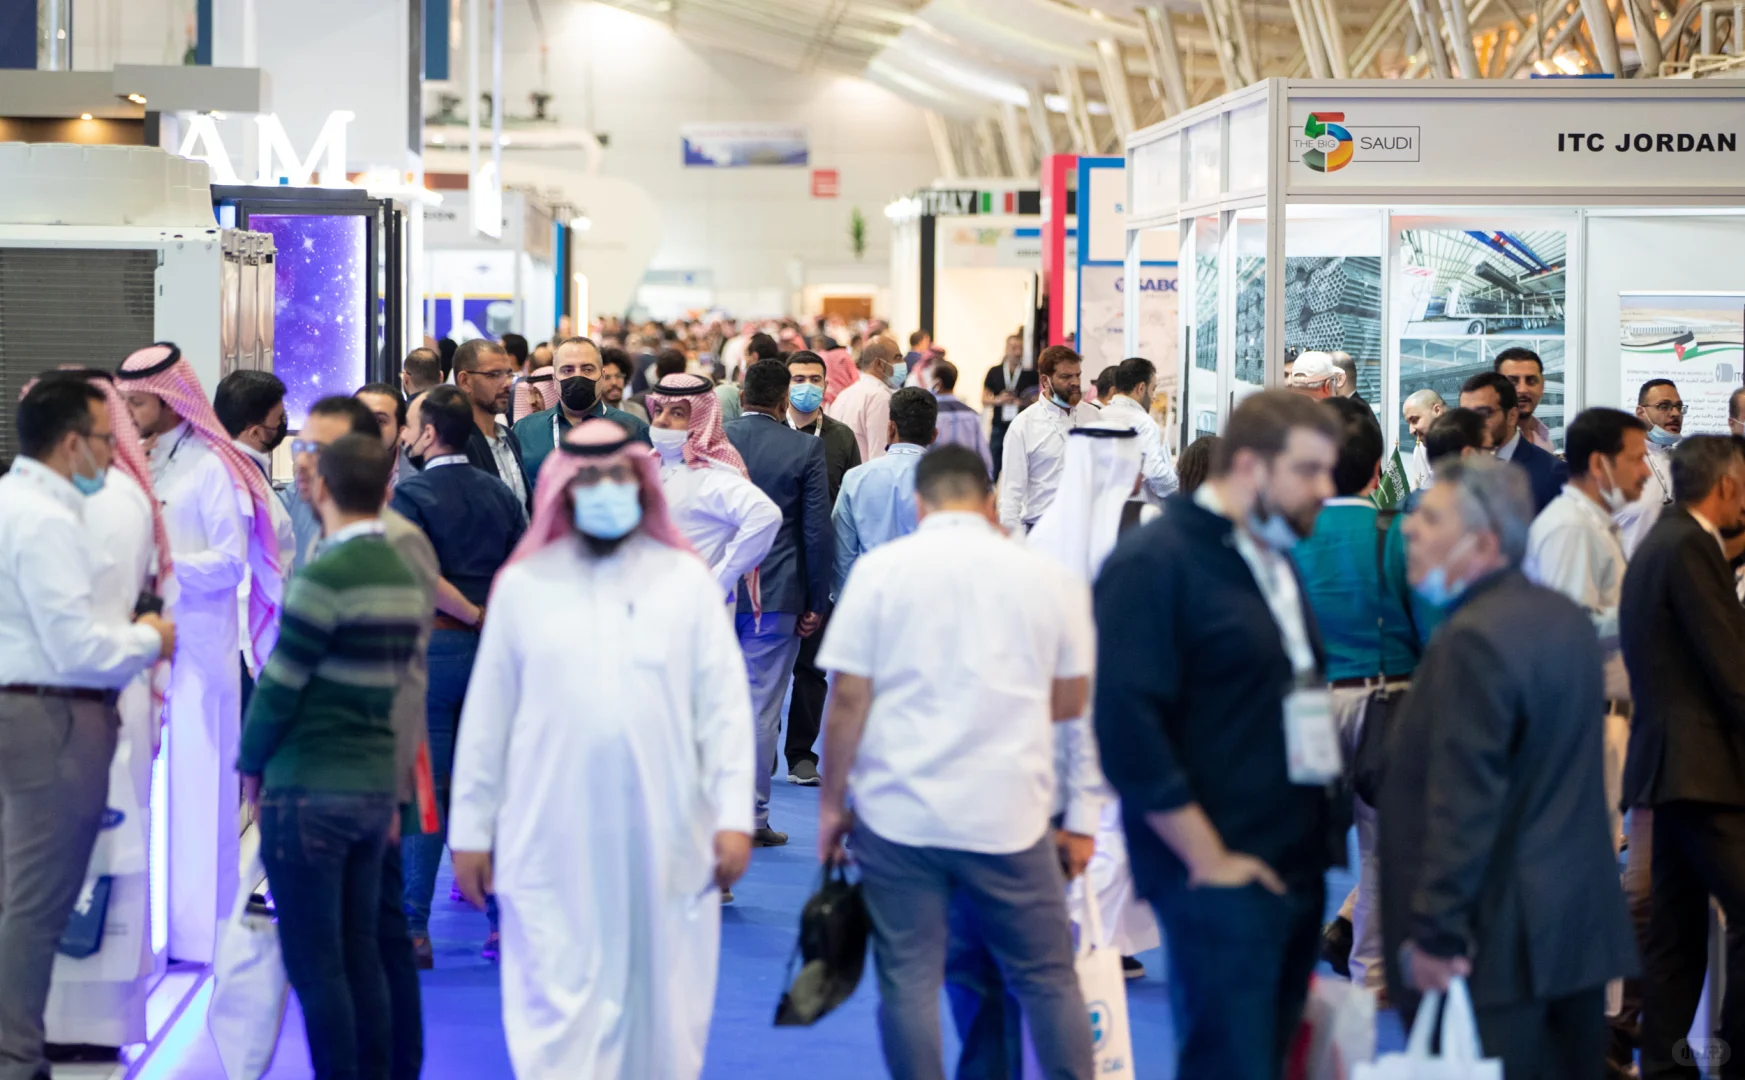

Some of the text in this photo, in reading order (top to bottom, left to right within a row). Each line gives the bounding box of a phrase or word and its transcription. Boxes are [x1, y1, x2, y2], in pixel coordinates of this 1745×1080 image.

[1294, 112, 1412, 173] THE BIG 5 SAUDI
[1558, 133, 1737, 152] ITC JORDAN
